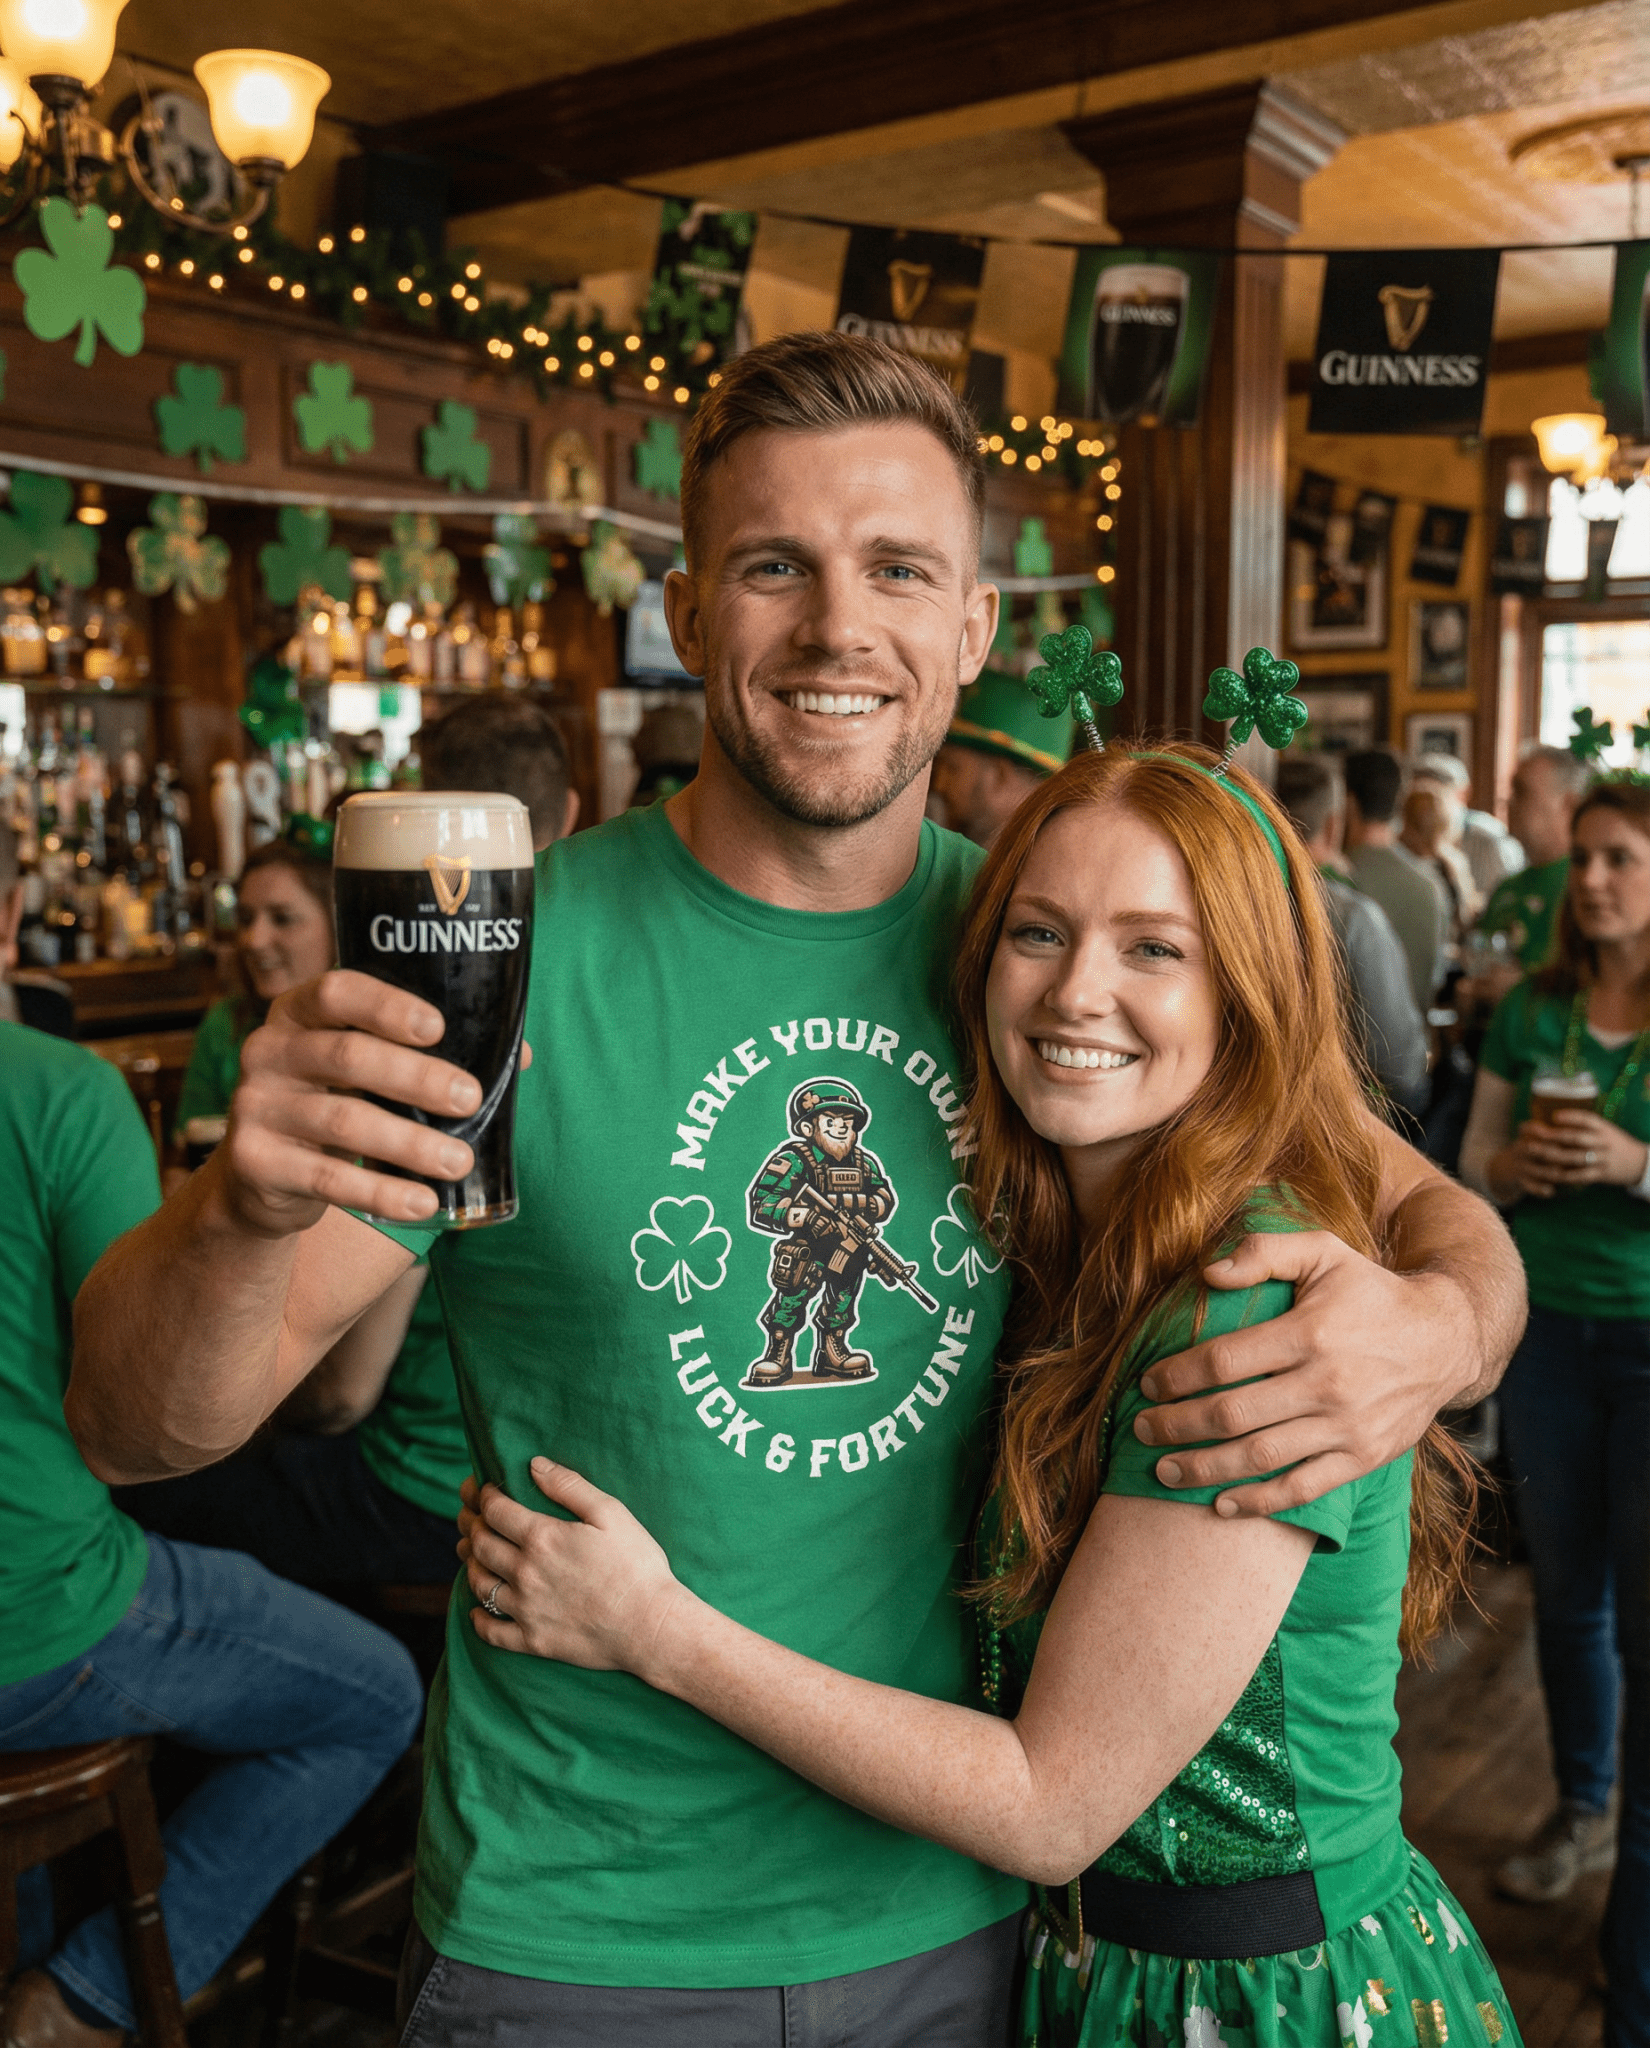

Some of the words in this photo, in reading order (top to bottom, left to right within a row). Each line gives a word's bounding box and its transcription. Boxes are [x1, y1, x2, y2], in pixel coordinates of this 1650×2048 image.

[1100, 304, 1177, 327] GUINNESS
[1320, 350, 1481, 386] GUINNESS
[370, 914, 522, 953] GUINNESS
[670, 1037, 771, 1171] MAKE
[769, 1017, 900, 1065] YOUR
[904, 1050, 979, 1161] OWN
[668, 1324, 764, 1457] LUCK
[765, 1432, 796, 1473] &
[809, 1305, 975, 1477] FORTUNE
